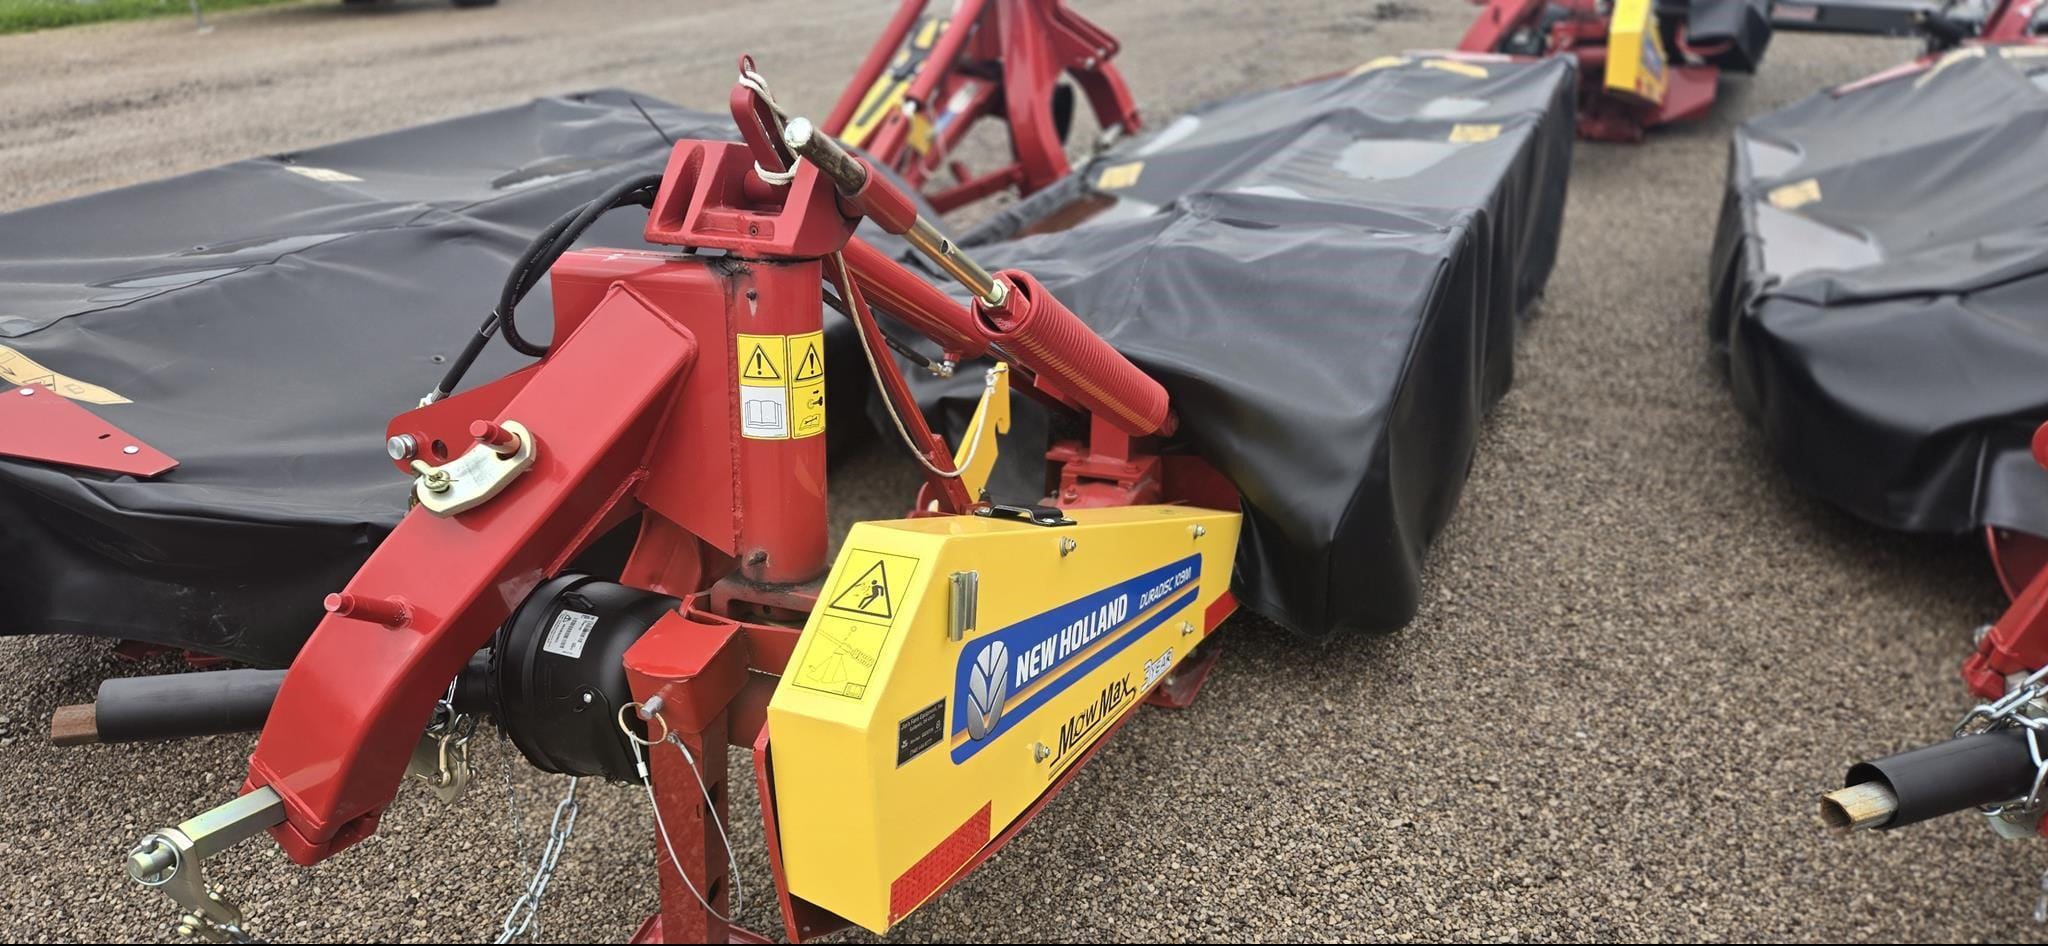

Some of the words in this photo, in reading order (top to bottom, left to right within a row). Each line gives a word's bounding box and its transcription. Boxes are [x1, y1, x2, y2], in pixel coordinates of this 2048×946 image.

[1015, 633, 1058, 688] NEW
[1059, 594, 1129, 660] HOLLAND
[1139, 576, 1174, 610] DURADISC
[1051, 700, 1099, 767] Mow
[1100, 672, 1134, 718] Max
